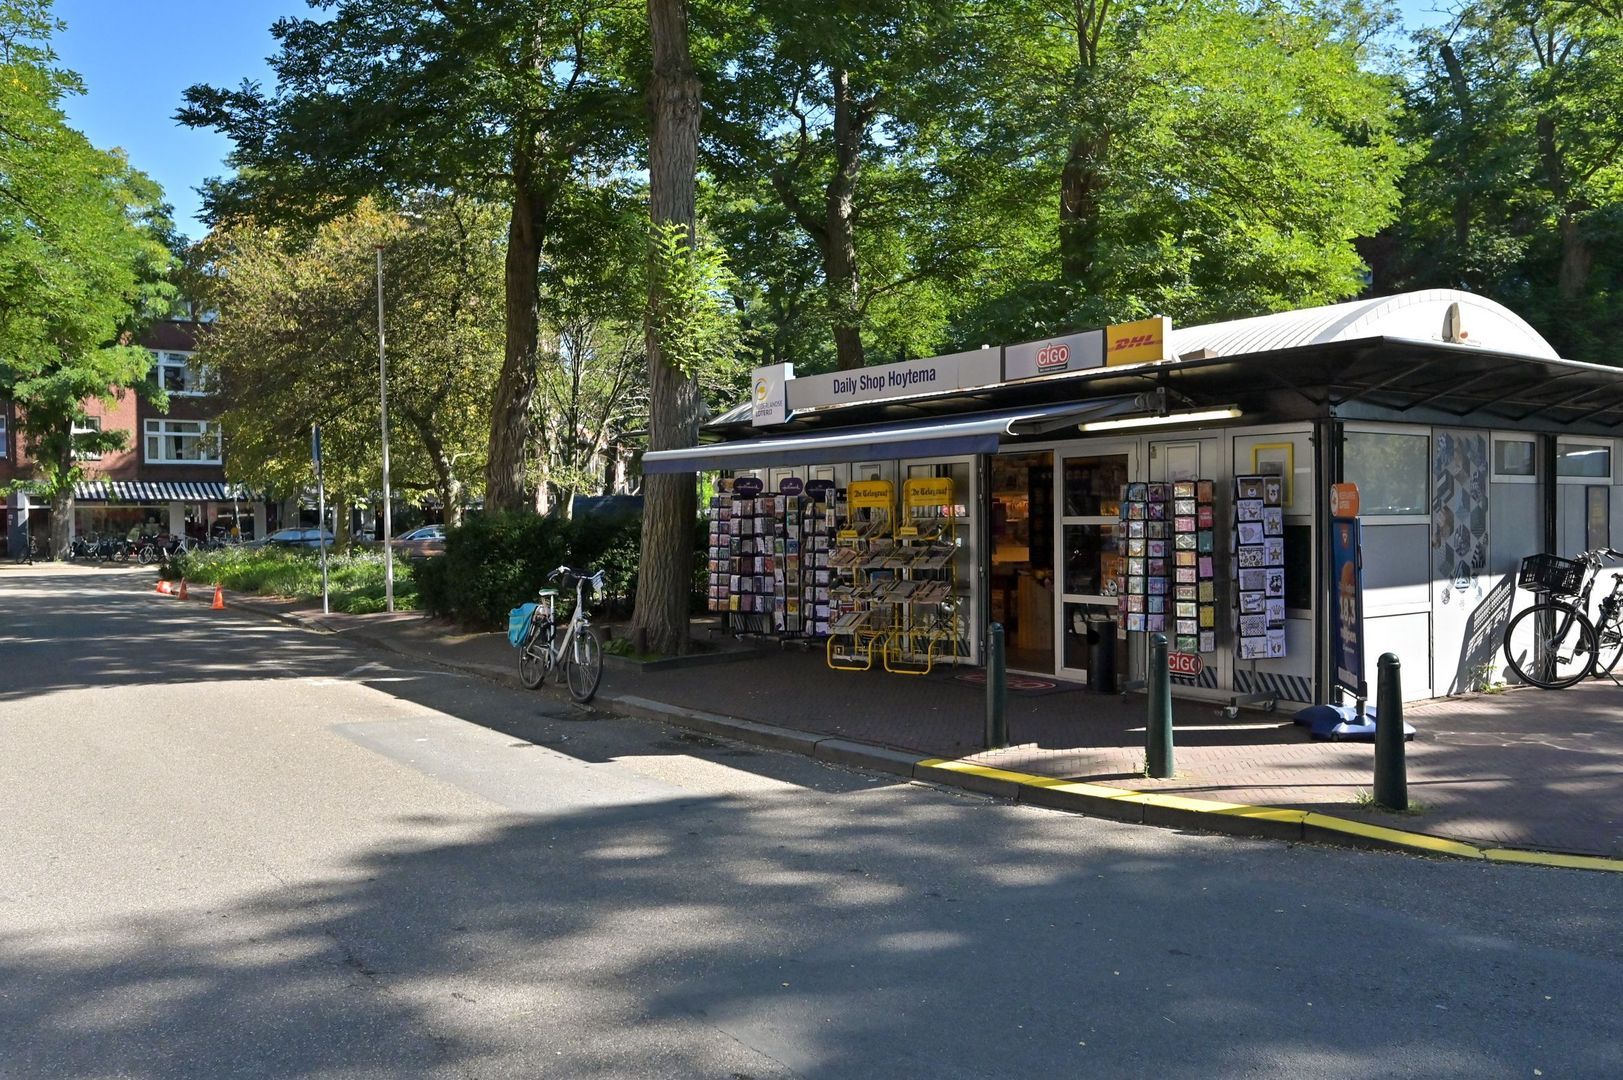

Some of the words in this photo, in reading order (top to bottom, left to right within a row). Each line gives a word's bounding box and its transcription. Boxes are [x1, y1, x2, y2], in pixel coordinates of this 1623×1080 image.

[1114, 334, 1155, 351] DHL
[833, 377, 857, 395] Daily
[860, 374, 885, 391] Shop
[888, 368, 936, 388] Hoytema
[862, 489, 888, 498] Telegraaf
[920, 488, 948, 497] Telegraaf
